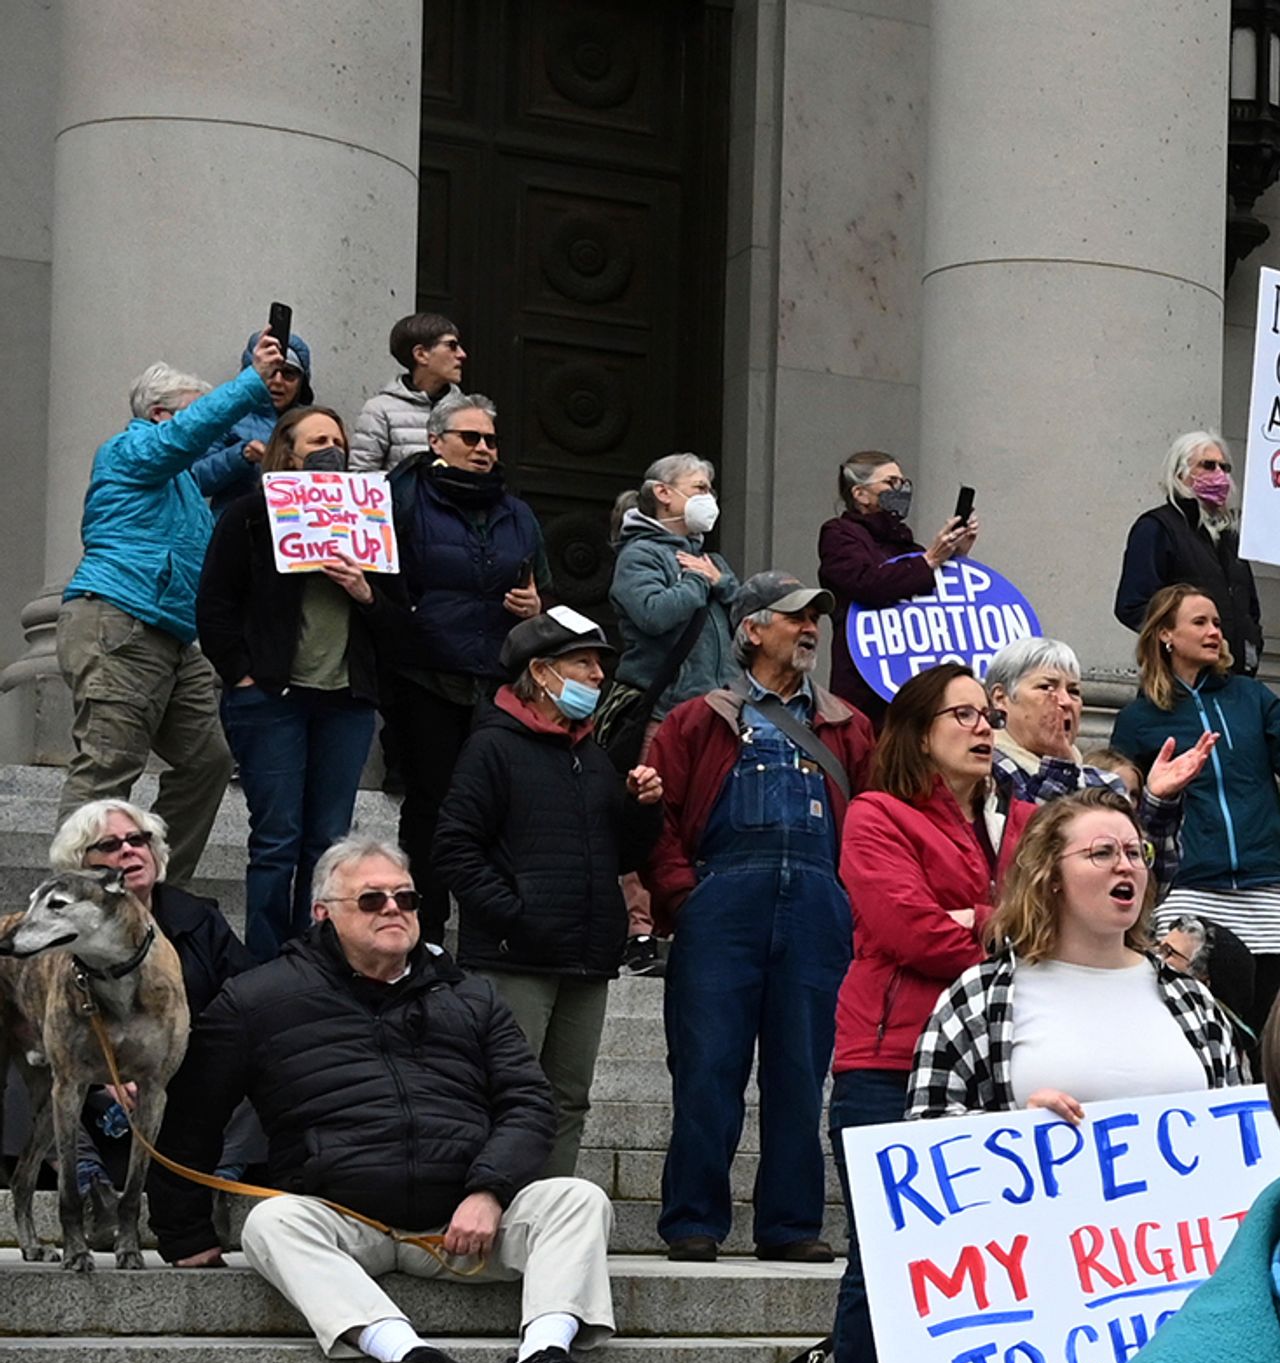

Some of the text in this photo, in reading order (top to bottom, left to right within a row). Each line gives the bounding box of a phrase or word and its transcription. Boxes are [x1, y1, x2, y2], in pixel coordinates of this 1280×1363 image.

[856, 604, 1032, 658] ABORTION
[875, 1099, 1271, 1231] RESPECT
[908, 1234, 1029, 1318] MY
